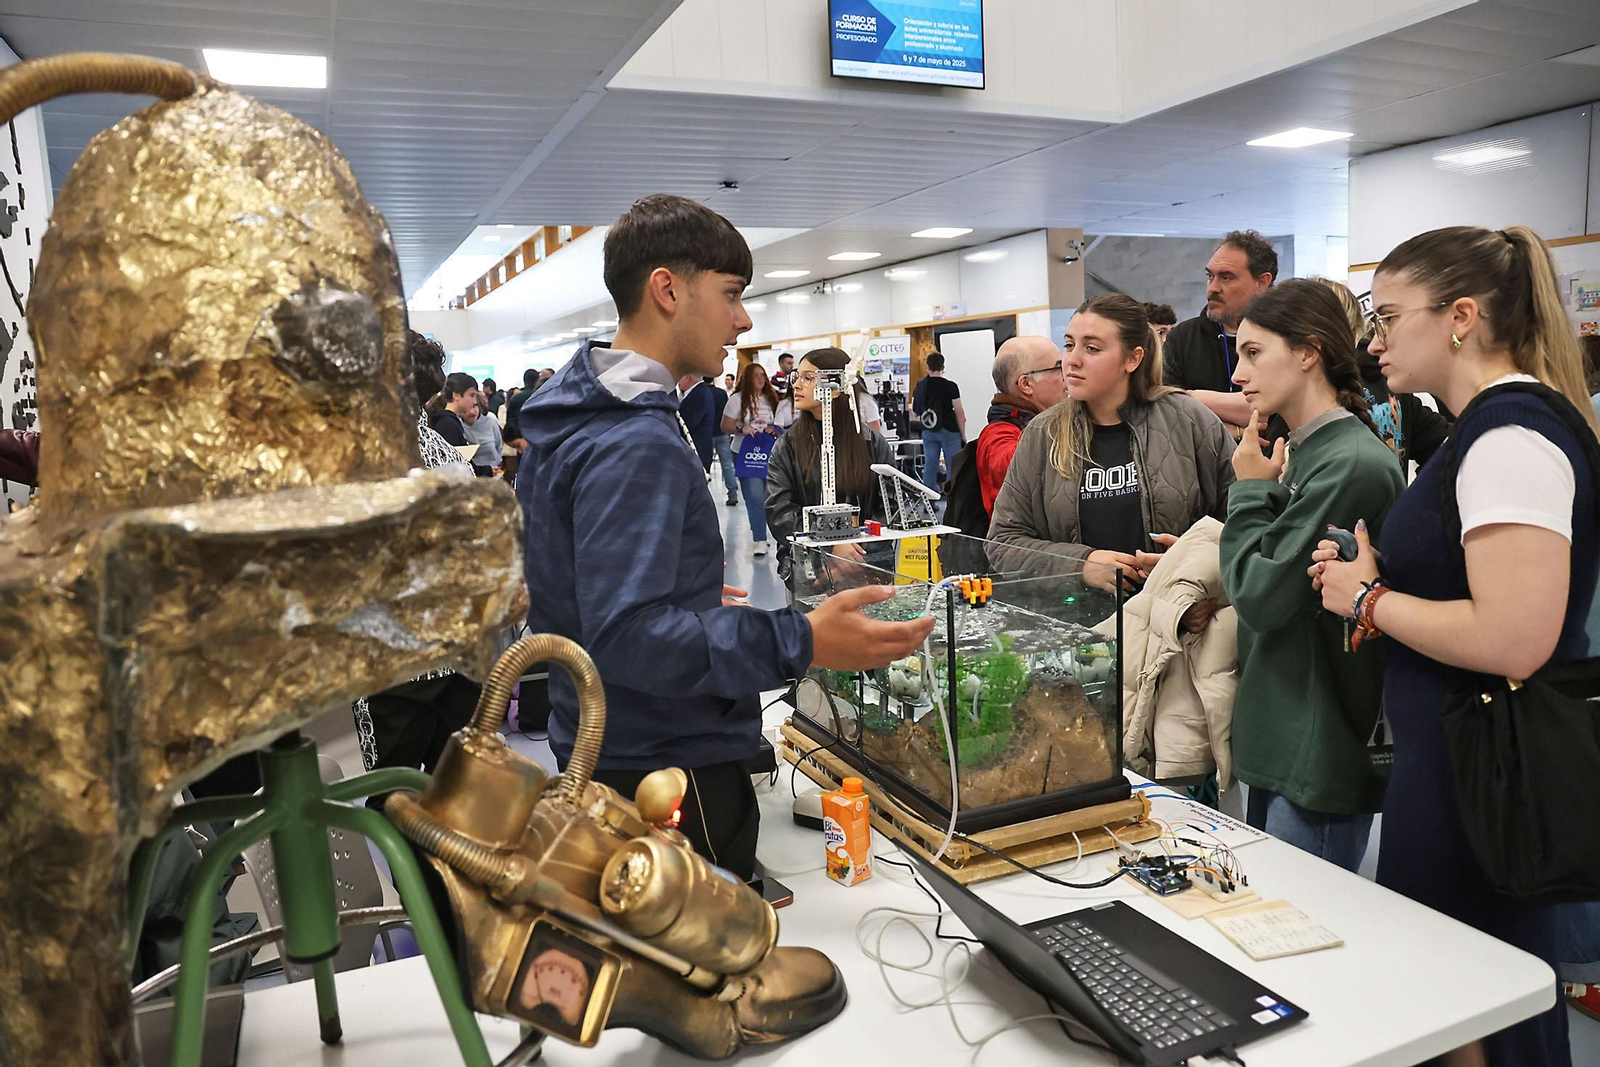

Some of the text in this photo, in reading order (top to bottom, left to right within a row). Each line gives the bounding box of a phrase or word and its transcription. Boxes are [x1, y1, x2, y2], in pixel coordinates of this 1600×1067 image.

[842, 14, 877, 25] CURSO DE
[836, 33, 877, 43] PROFESORADO
[904, 40, 935, 49] profesorado
[939, 44, 964, 52] alumnado
[903, 54, 908, 62] 6
[927, 58, 943, 66] mayo
[943, 58, 951, 66] de
[952, 59, 967, 68] 2025
[1094, 490, 1114, 499] FIVE
[1115, 485, 1140, 496] BASK
